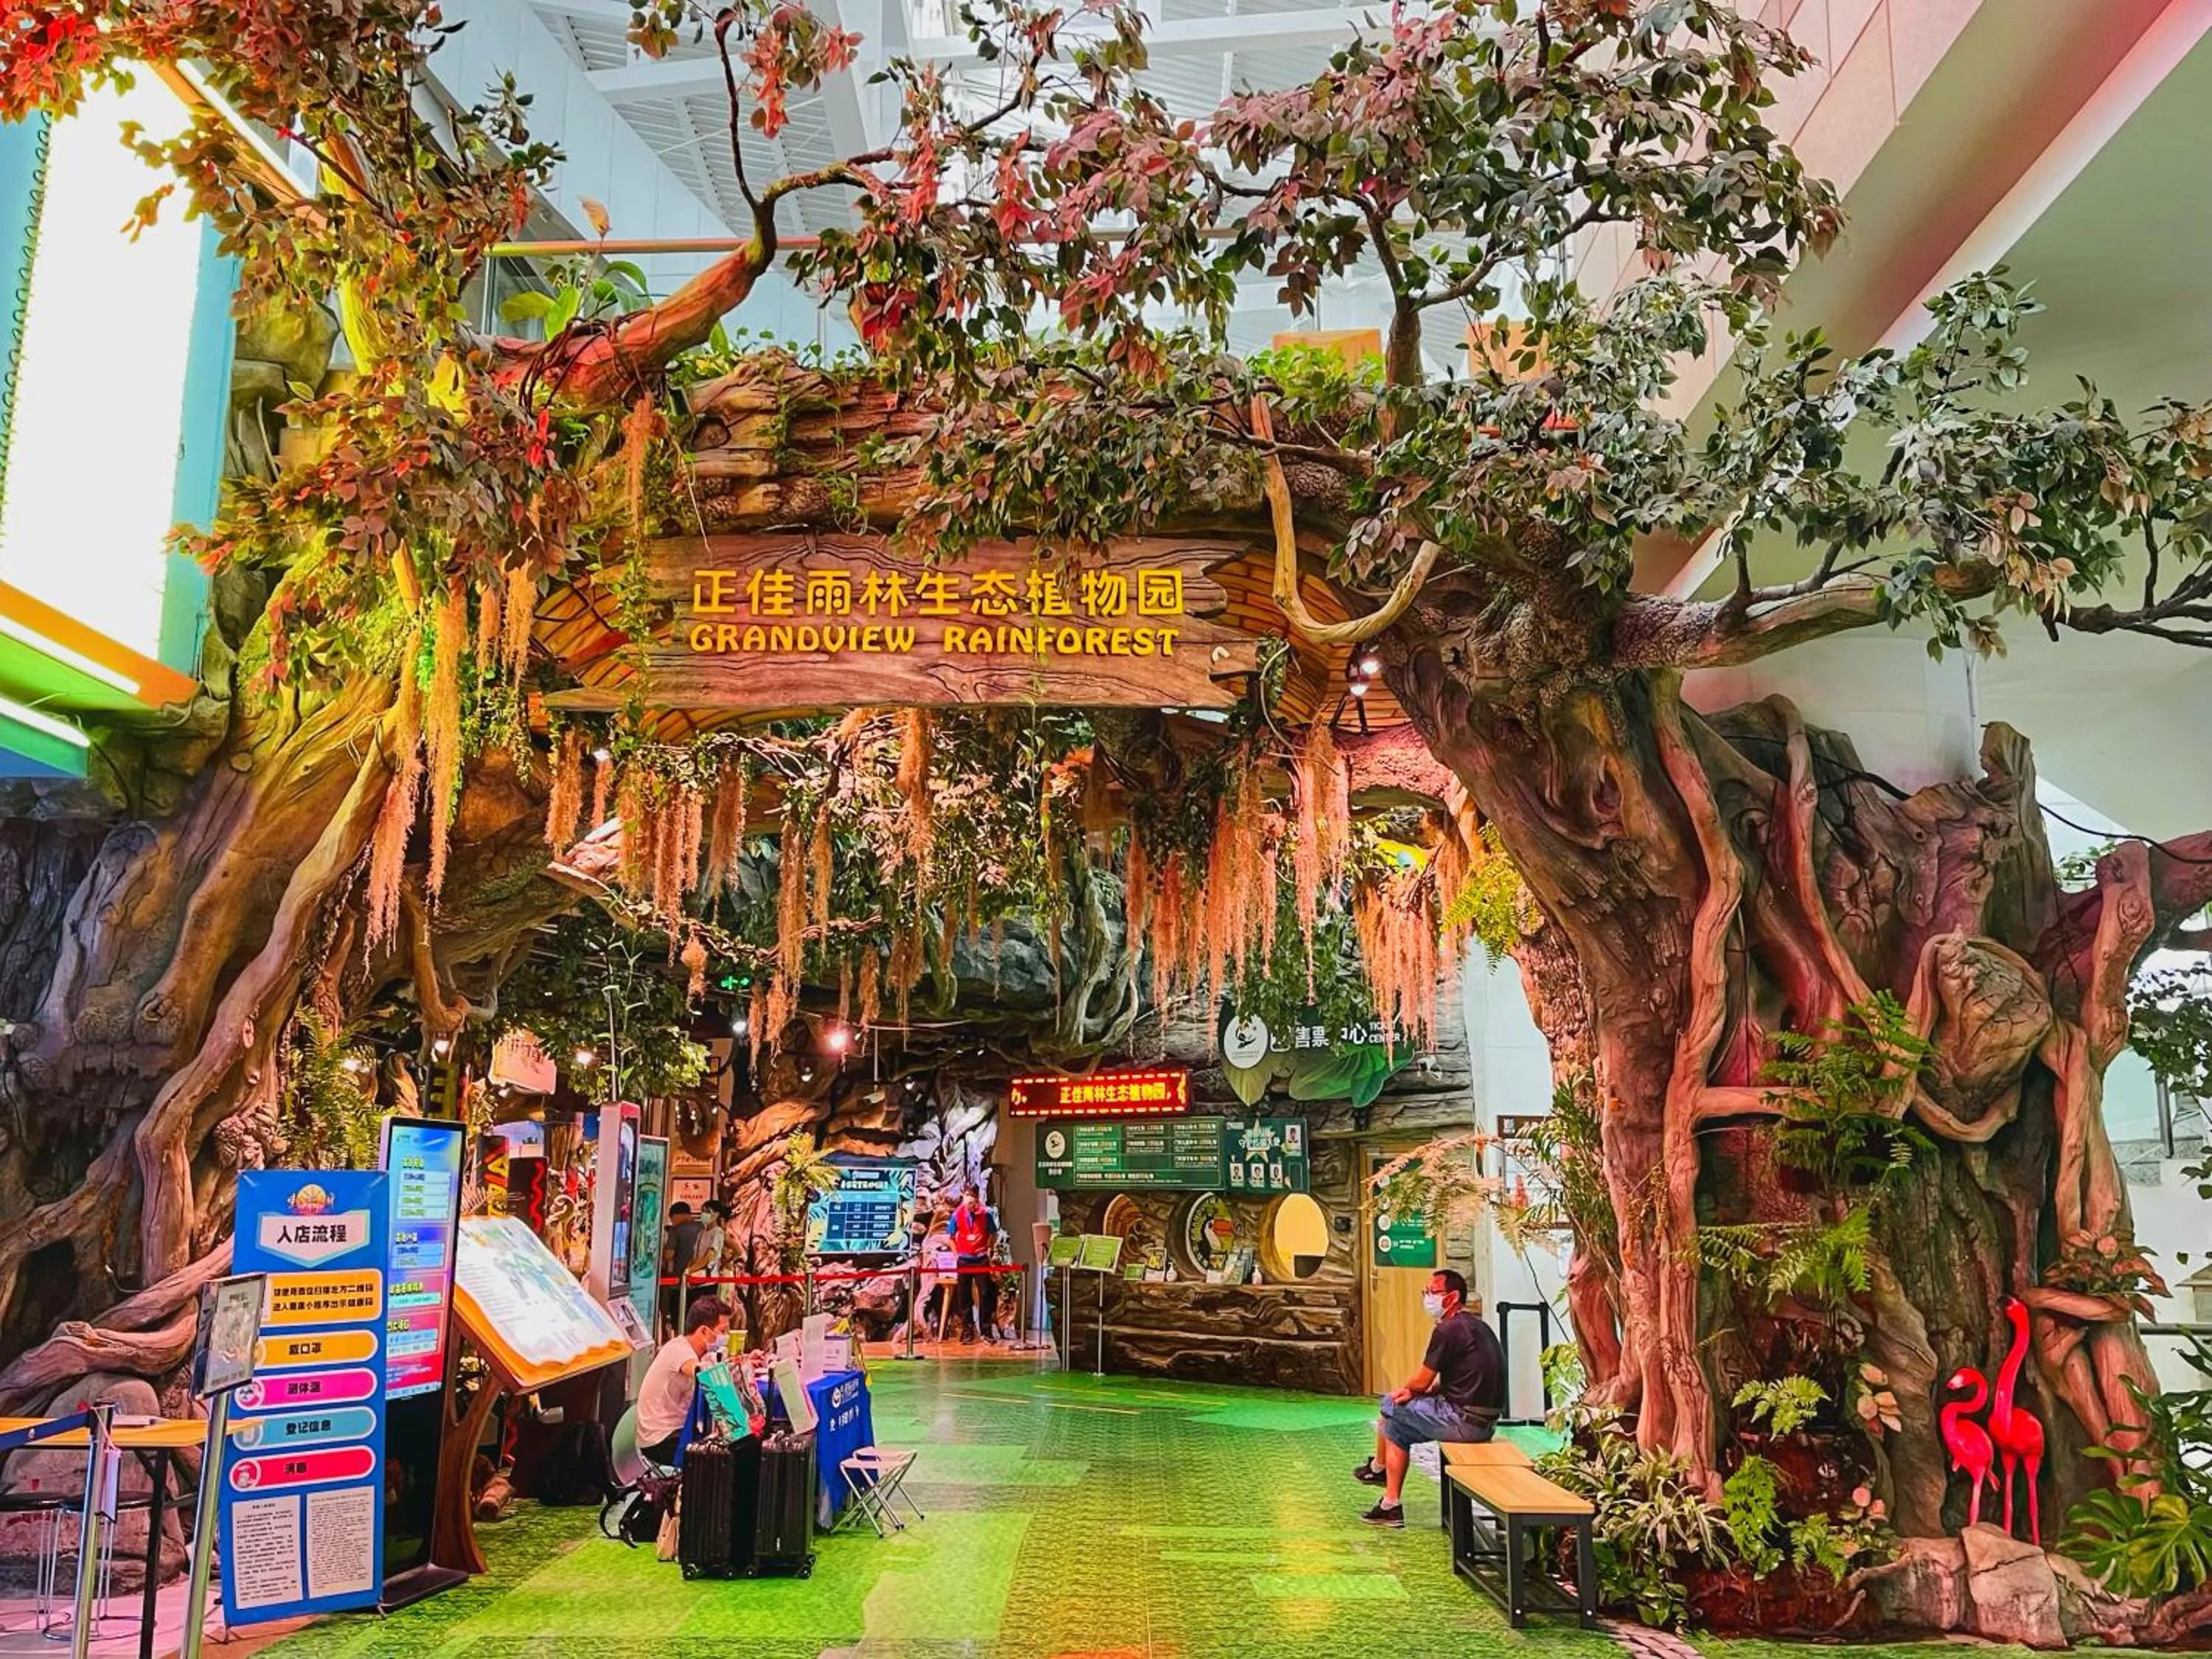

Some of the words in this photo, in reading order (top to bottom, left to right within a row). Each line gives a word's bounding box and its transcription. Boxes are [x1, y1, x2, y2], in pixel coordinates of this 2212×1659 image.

[692, 568, 1185, 617] 正佳雨林生态植物园
[690, 623, 916, 653] GRANDVIEW
[944, 625, 1180, 656] RAINFOREST
